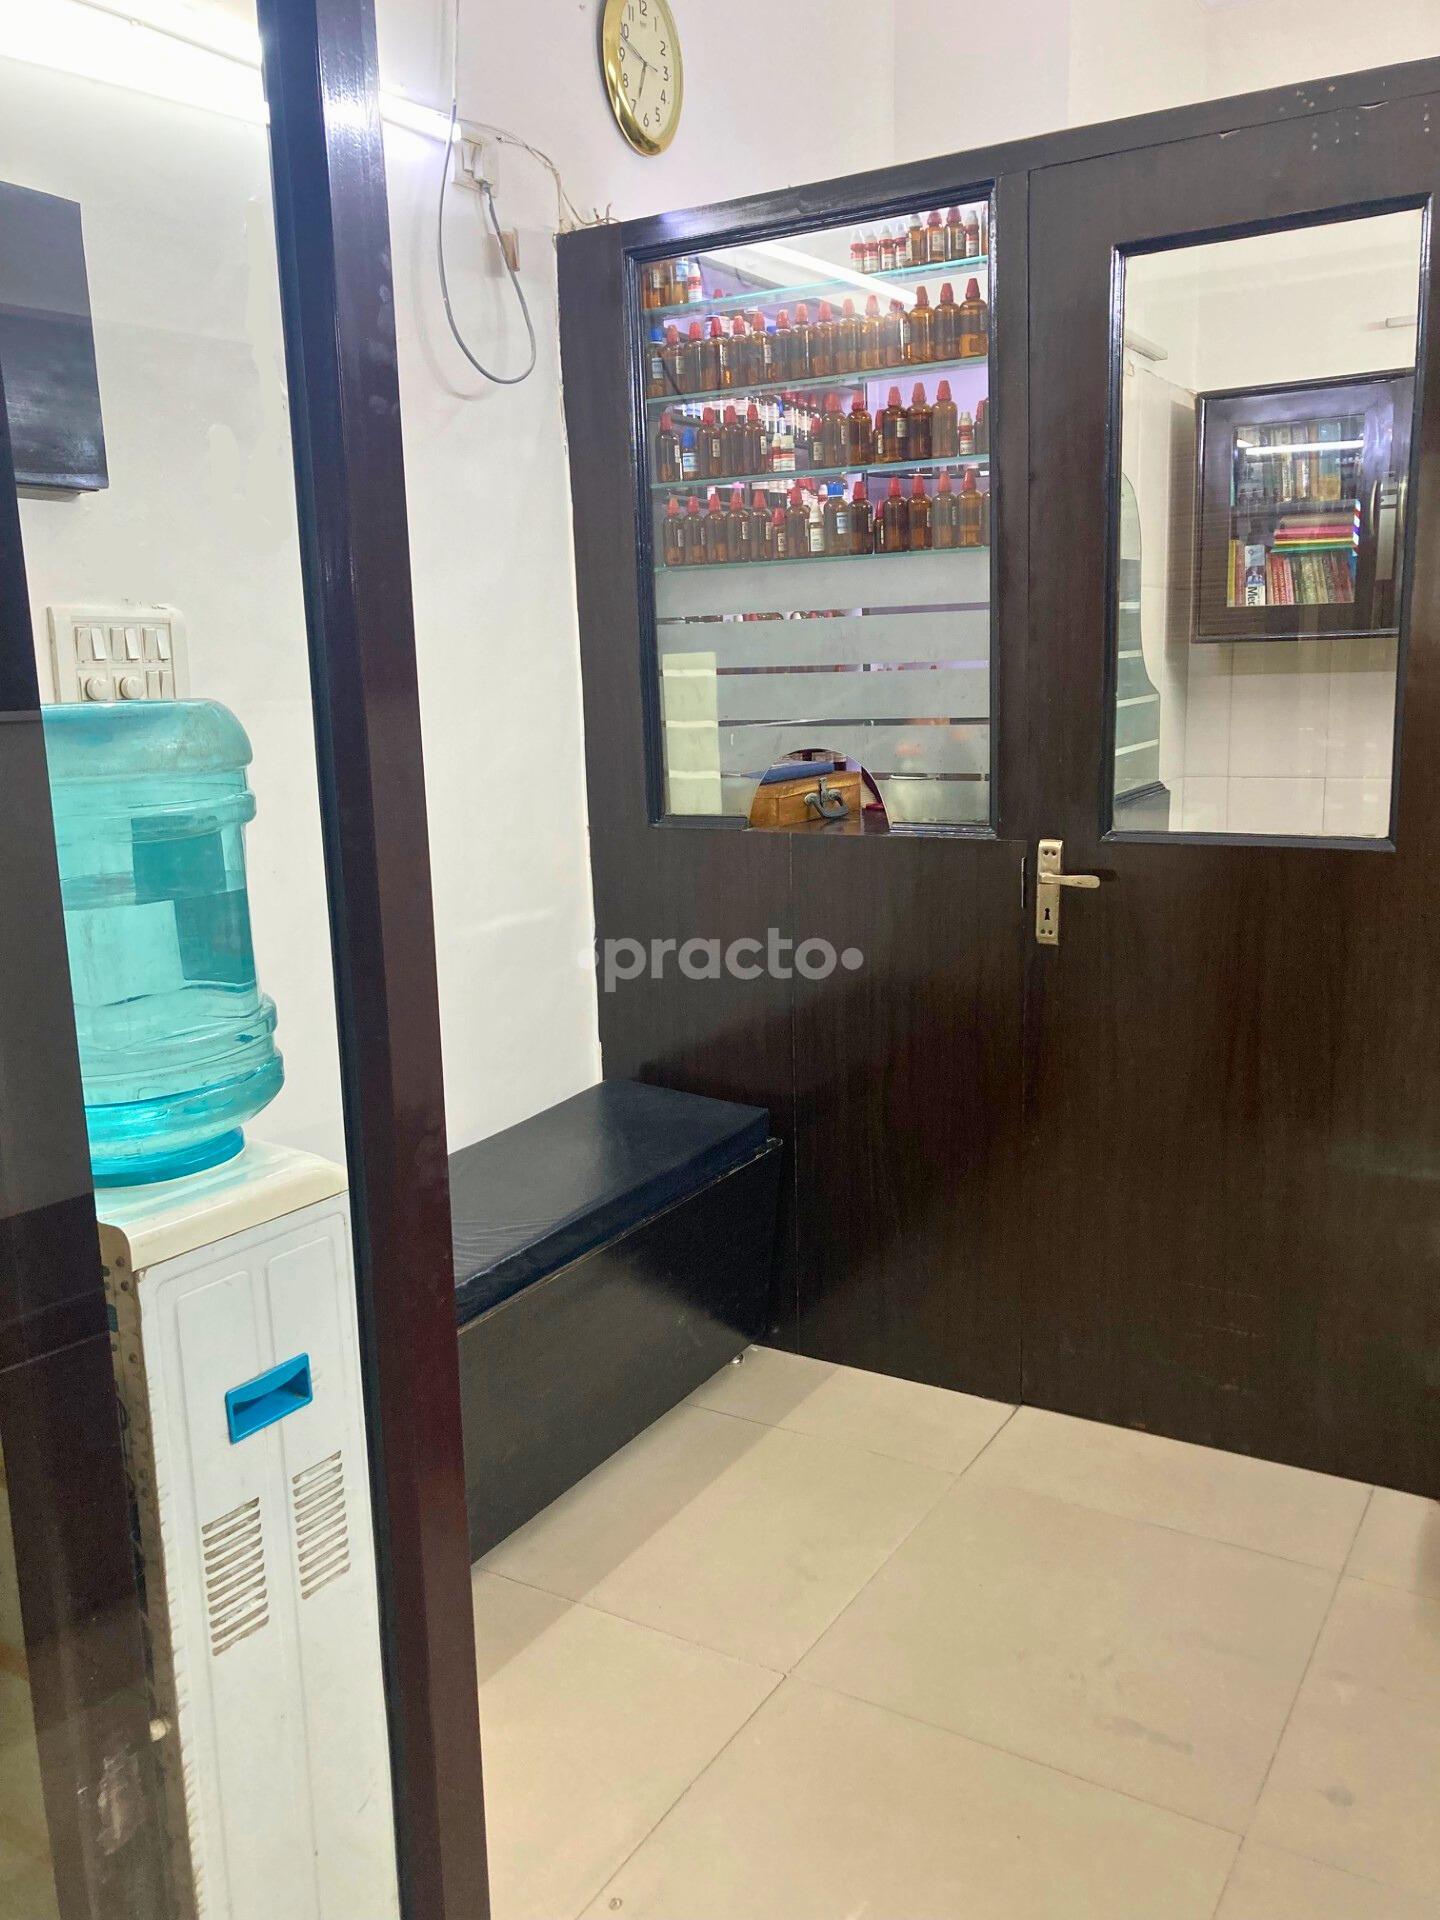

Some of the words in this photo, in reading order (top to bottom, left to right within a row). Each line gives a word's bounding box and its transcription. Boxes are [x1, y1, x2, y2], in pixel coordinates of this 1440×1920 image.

[628, 4, 635, 22] 11
[639, 0, 648, 16] 12
[619, 47, 626, 62] 9
[659, 41, 667, 57] 2
[623, 73, 629, 88] 8
[663, 66, 669, 82] 3
[660, 89, 667, 104] 4
[631, 99, 637, 113] 7
[643, 113, 650, 128] 6
[655, 108, 661, 122] 5
